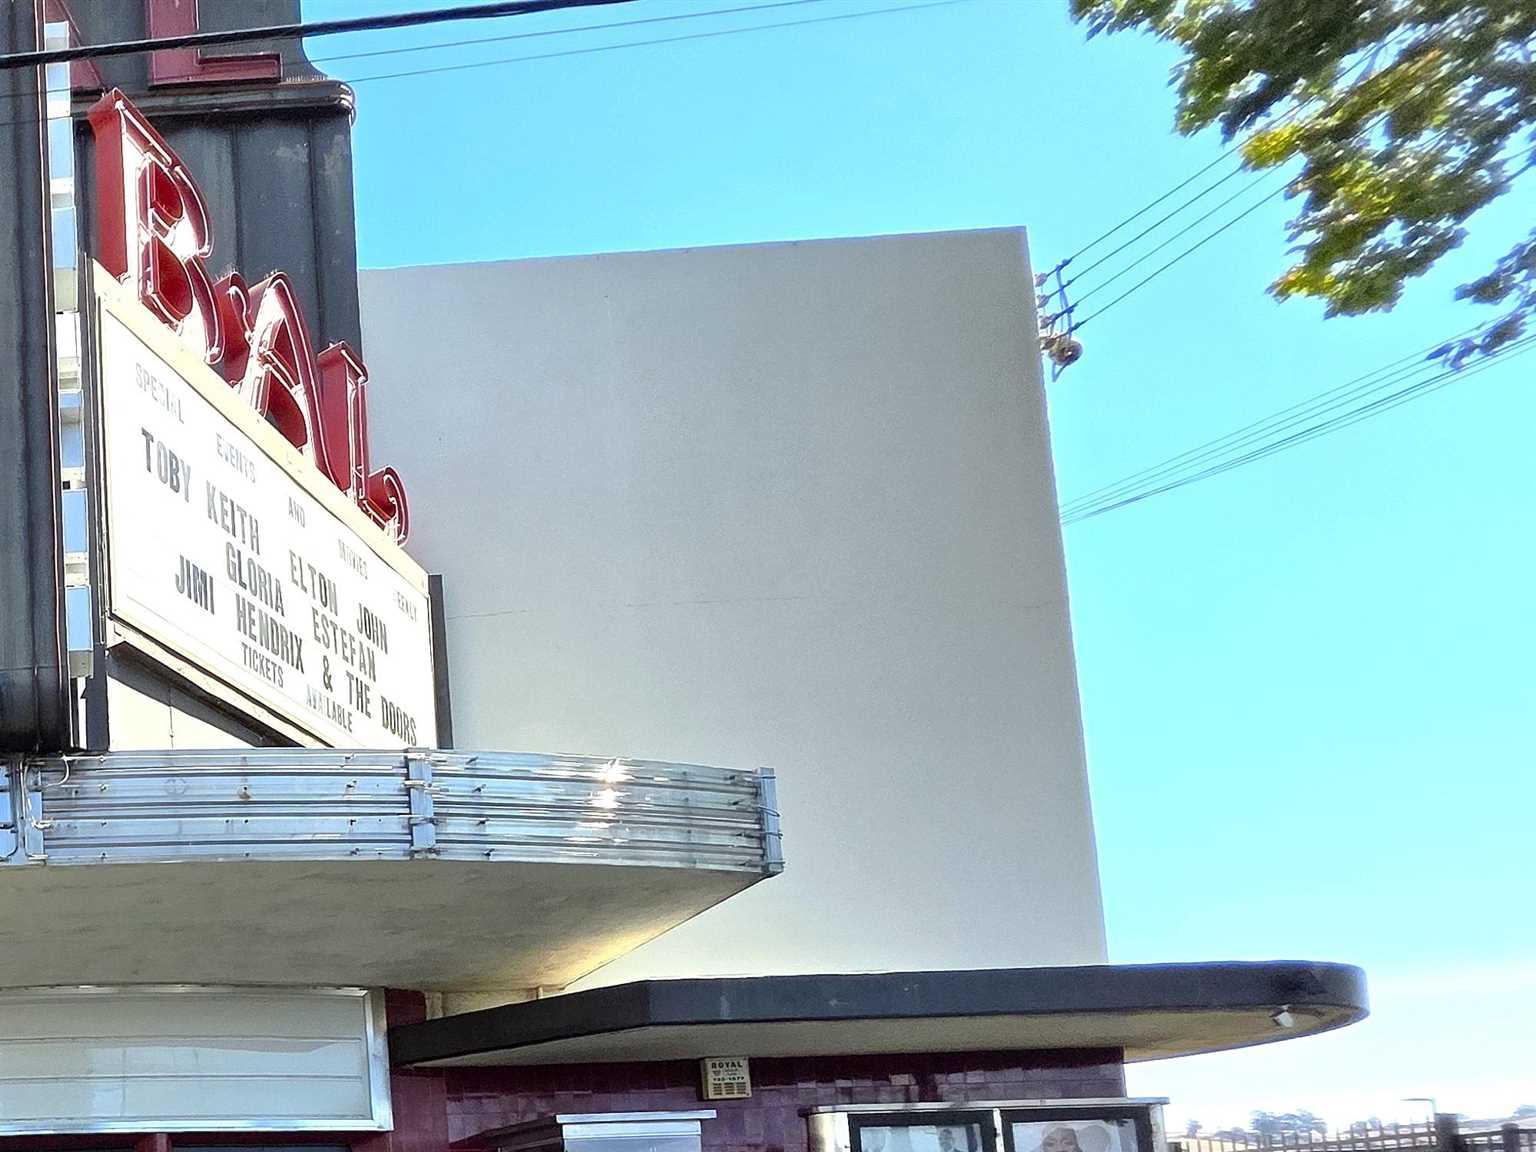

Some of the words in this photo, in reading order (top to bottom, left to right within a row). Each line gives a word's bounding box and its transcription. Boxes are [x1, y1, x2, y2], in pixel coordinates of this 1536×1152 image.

[141, 426, 191, 504] TOBY
[205, 480, 260, 556] KEITH
[288, 549, 338, 617] ELTON
[356, 602, 388, 655] JOHN
[288, 496, 305, 528] AND
[175, 554, 215, 615] JIMI
[235, 593, 304, 674] HENDRIX
[323, 655, 333, 692] &
[345, 669, 372, 719] THE
[380, 695, 417, 746] DOORS
[225, 541, 285, 617] GLORIA
[311, 606, 376, 682] ESTEFAN
[241, 641, 284, 688] TICKETS
[711, 1061, 744, 1069] ROYAL
